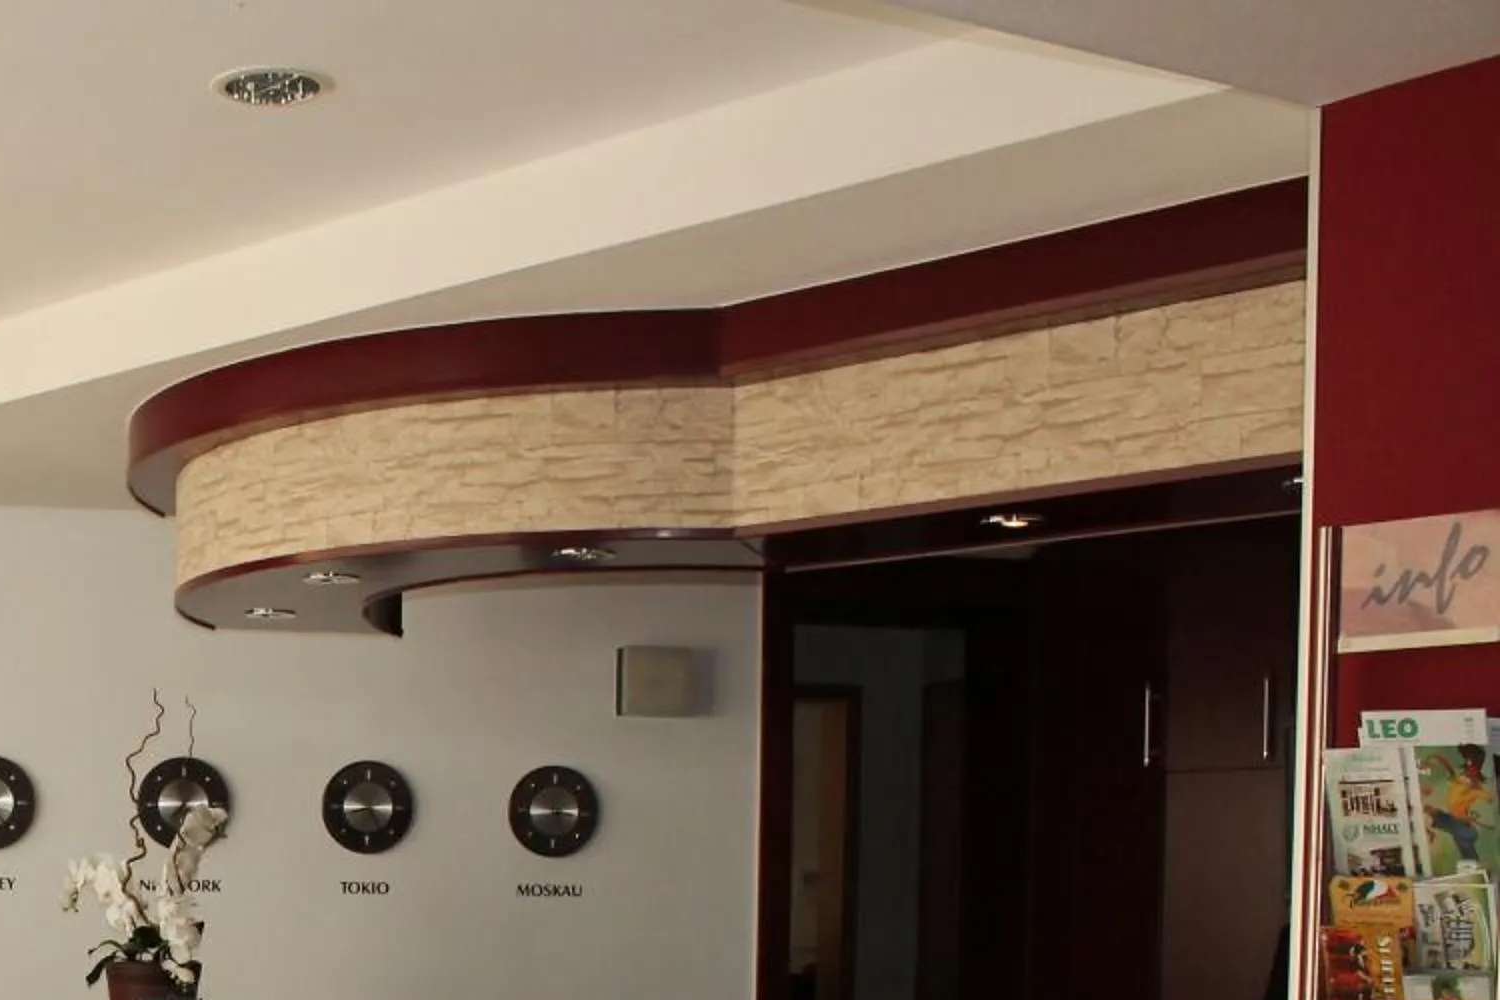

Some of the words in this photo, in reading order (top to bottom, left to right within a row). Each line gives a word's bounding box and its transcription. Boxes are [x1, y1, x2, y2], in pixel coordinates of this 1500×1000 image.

[1361, 520, 1490, 615] info
[1366, 717, 1420, 739] LEO
[179, 879, 222, 893] ORK
[340, 881, 390, 895] TOKIO
[516, 883, 583, 898] MOSKAU
